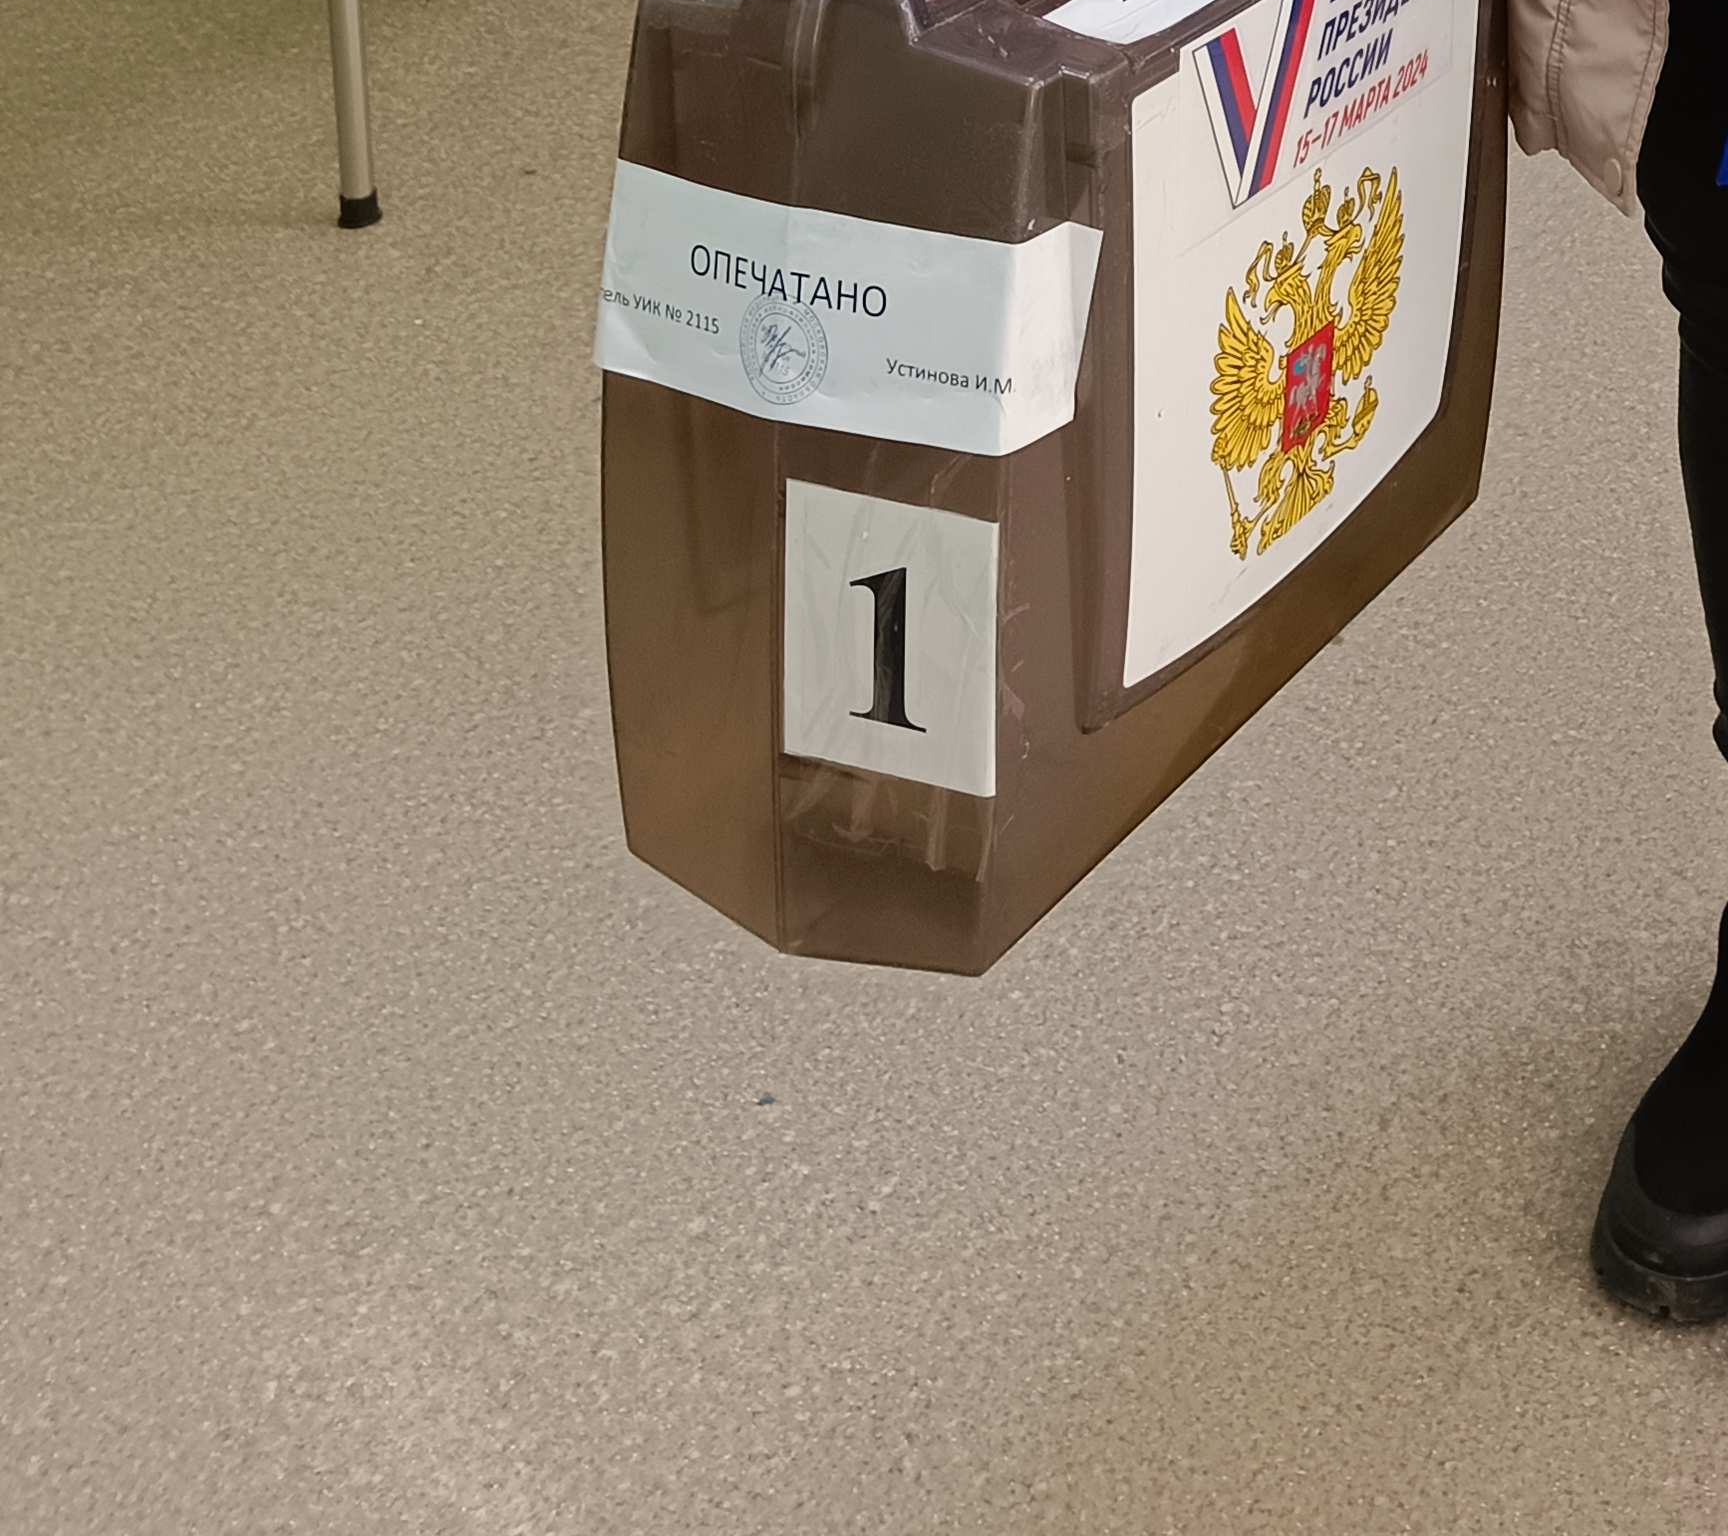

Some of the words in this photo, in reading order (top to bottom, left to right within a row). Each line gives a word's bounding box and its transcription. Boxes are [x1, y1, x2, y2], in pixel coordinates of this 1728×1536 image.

[1303, 28, 1394, 120] РОССИИ
[1338, 83, 1392, 139] МАРТА
[1392, 48, 1429, 97] 2024
[633, 293, 661, 316] УИК
[665, 304, 682, 322] №
[686, 309, 719, 334] 2115
[690, 244, 888, 318] ОПЕЧАТАНО
[886, 358, 969, 388] Устинова
[849, 567, 927, 733] 1
